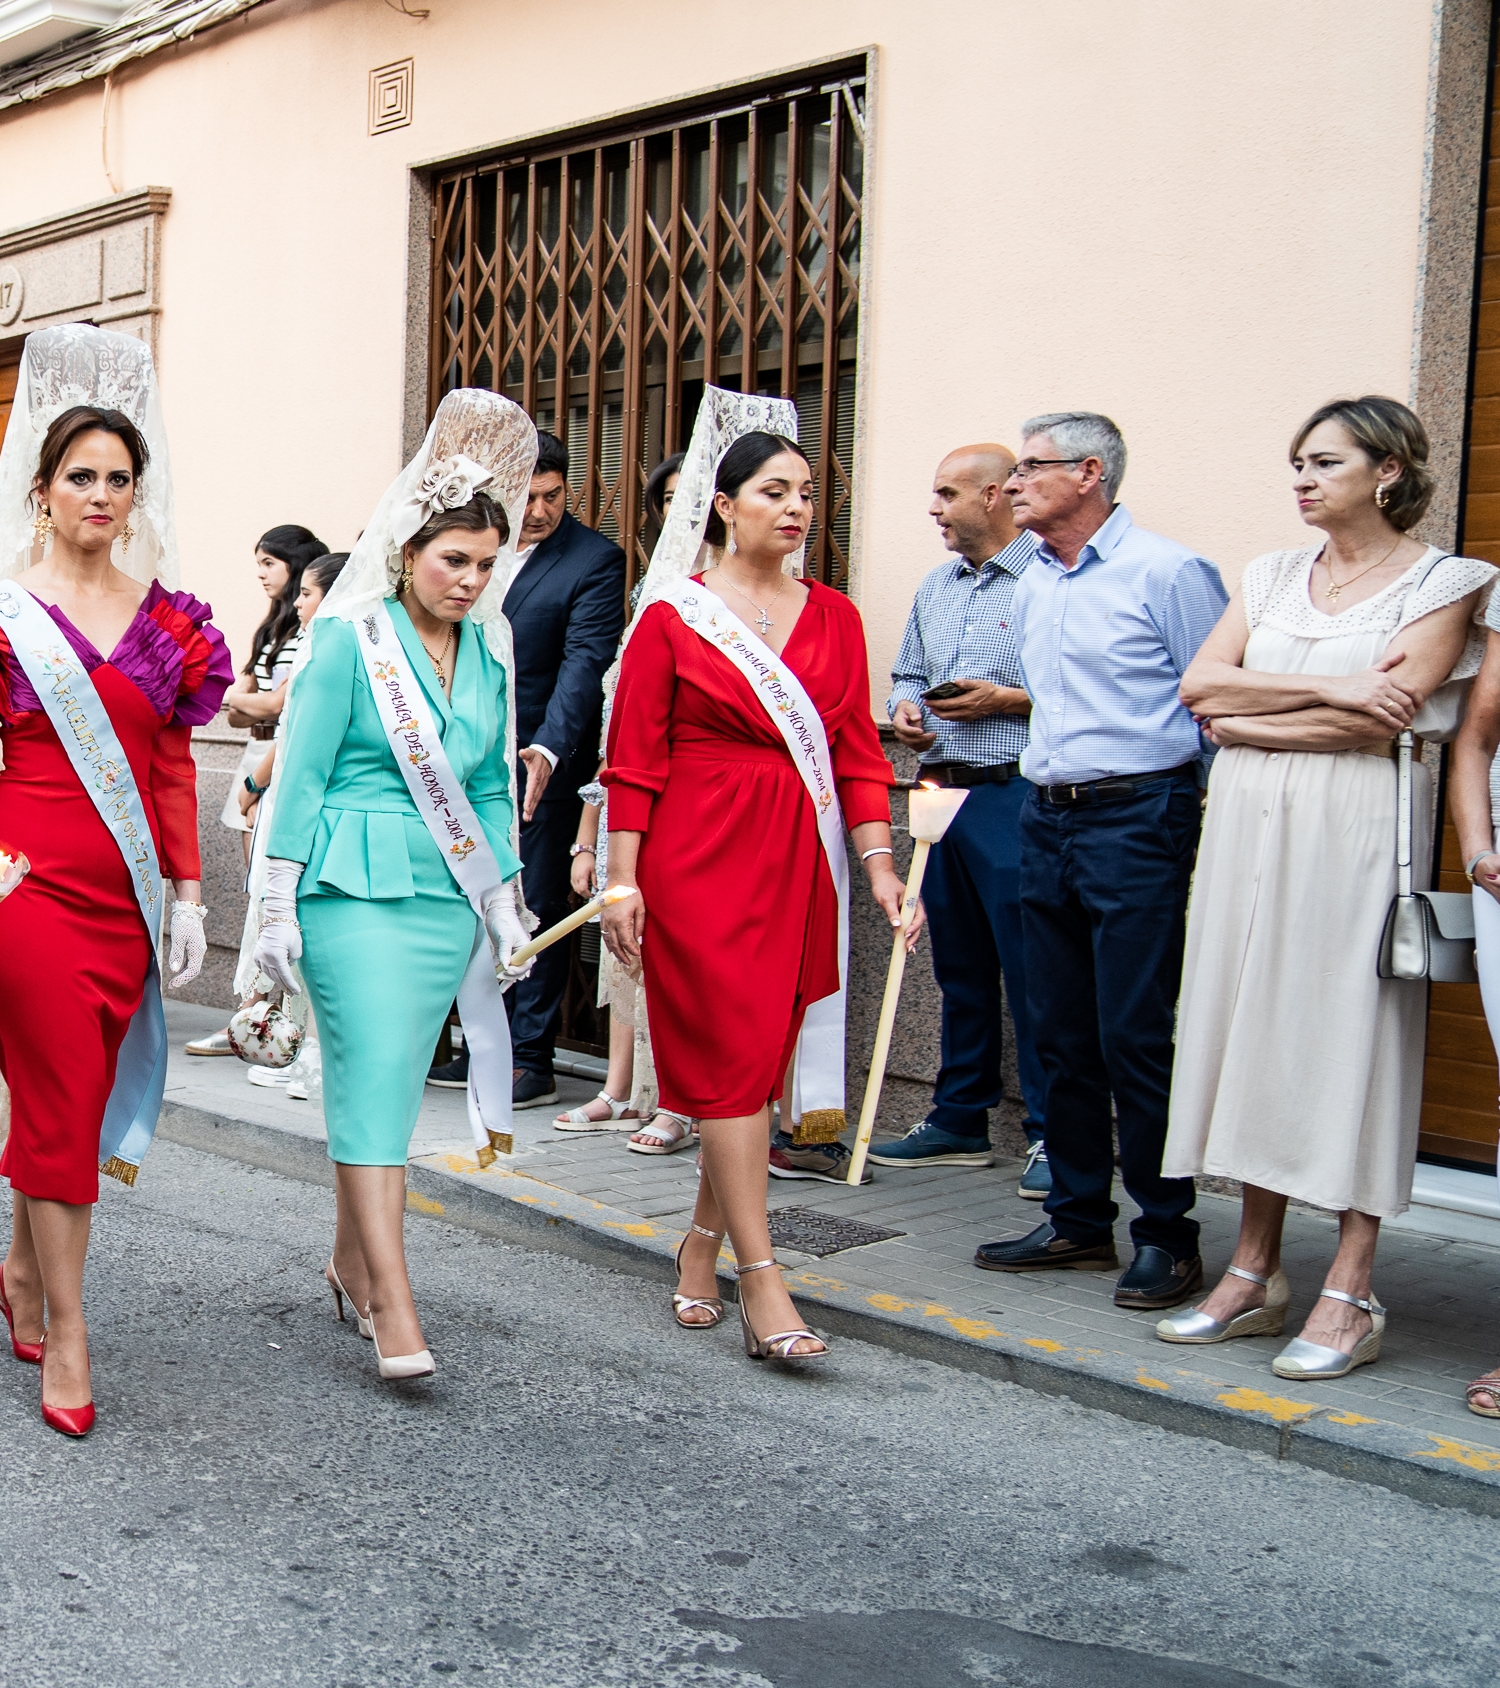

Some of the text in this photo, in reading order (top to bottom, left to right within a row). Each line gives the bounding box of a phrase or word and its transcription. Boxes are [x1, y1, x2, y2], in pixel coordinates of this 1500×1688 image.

[0, 283, 14, 309] 17
[731, 642, 770, 676] DAMA
[767, 682, 789, 703] DE
[385, 681, 413, 724] DAMA
[403, 730, 424, 754] DE
